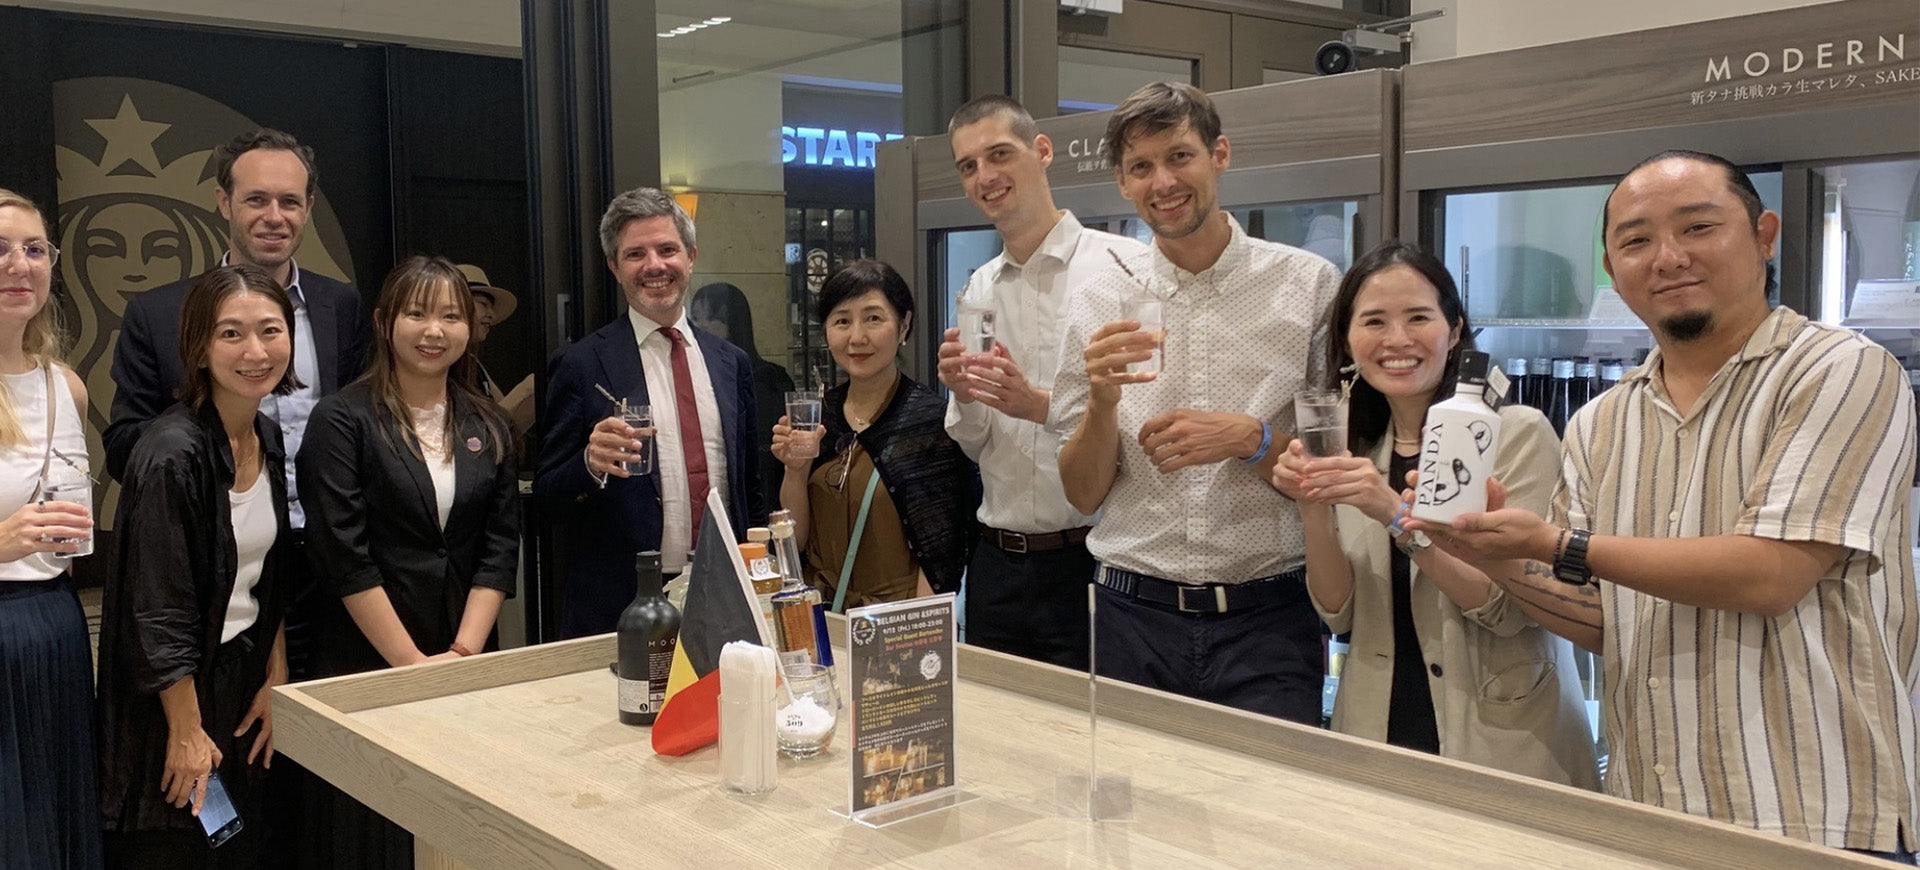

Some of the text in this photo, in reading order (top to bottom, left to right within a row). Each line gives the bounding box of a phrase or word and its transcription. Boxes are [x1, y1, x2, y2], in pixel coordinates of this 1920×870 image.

[1704, 34, 1904, 82] MODERN
[782, 126, 904, 168] STAR
[1418, 423, 1443, 506] PANDA
[877, 613, 906, 626] BELGIAN
[907, 611, 920, 621] GIN
